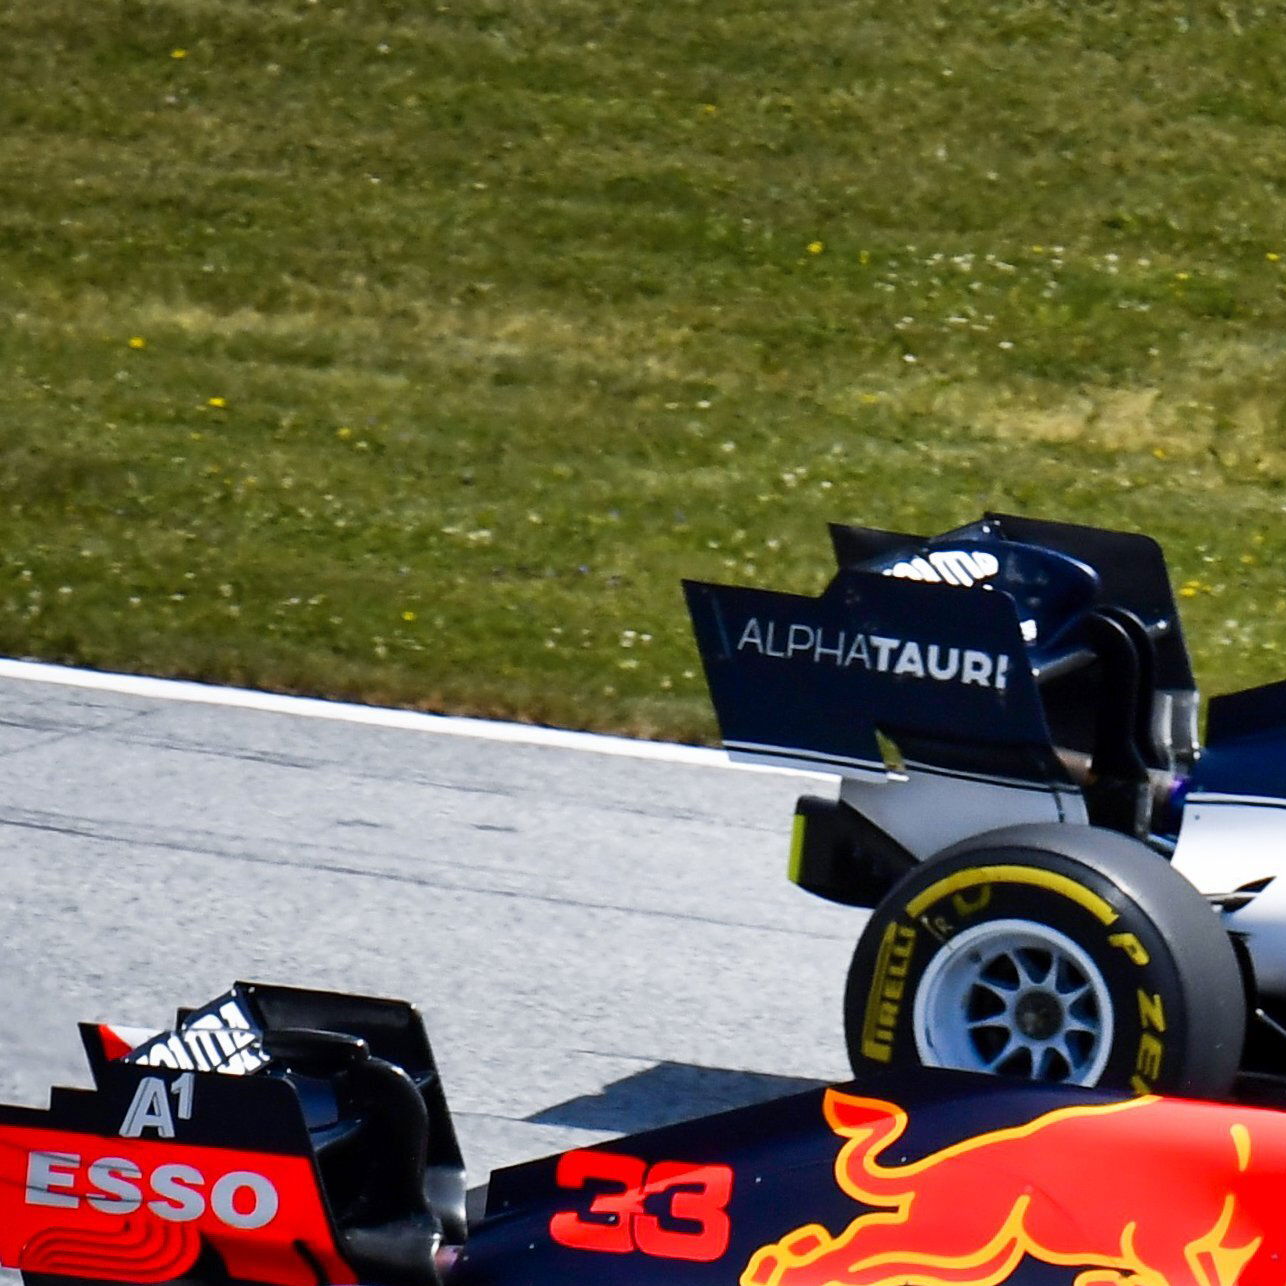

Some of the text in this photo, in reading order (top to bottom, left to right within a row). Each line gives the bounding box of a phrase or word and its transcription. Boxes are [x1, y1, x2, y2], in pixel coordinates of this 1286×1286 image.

[738, 616, 1008, 689] ALPHATAURI
[861, 921, 917, 1063] PIRELLI
[24, 1150, 279, 1229] ESSO
[549, 1149, 735, 1262] 33
